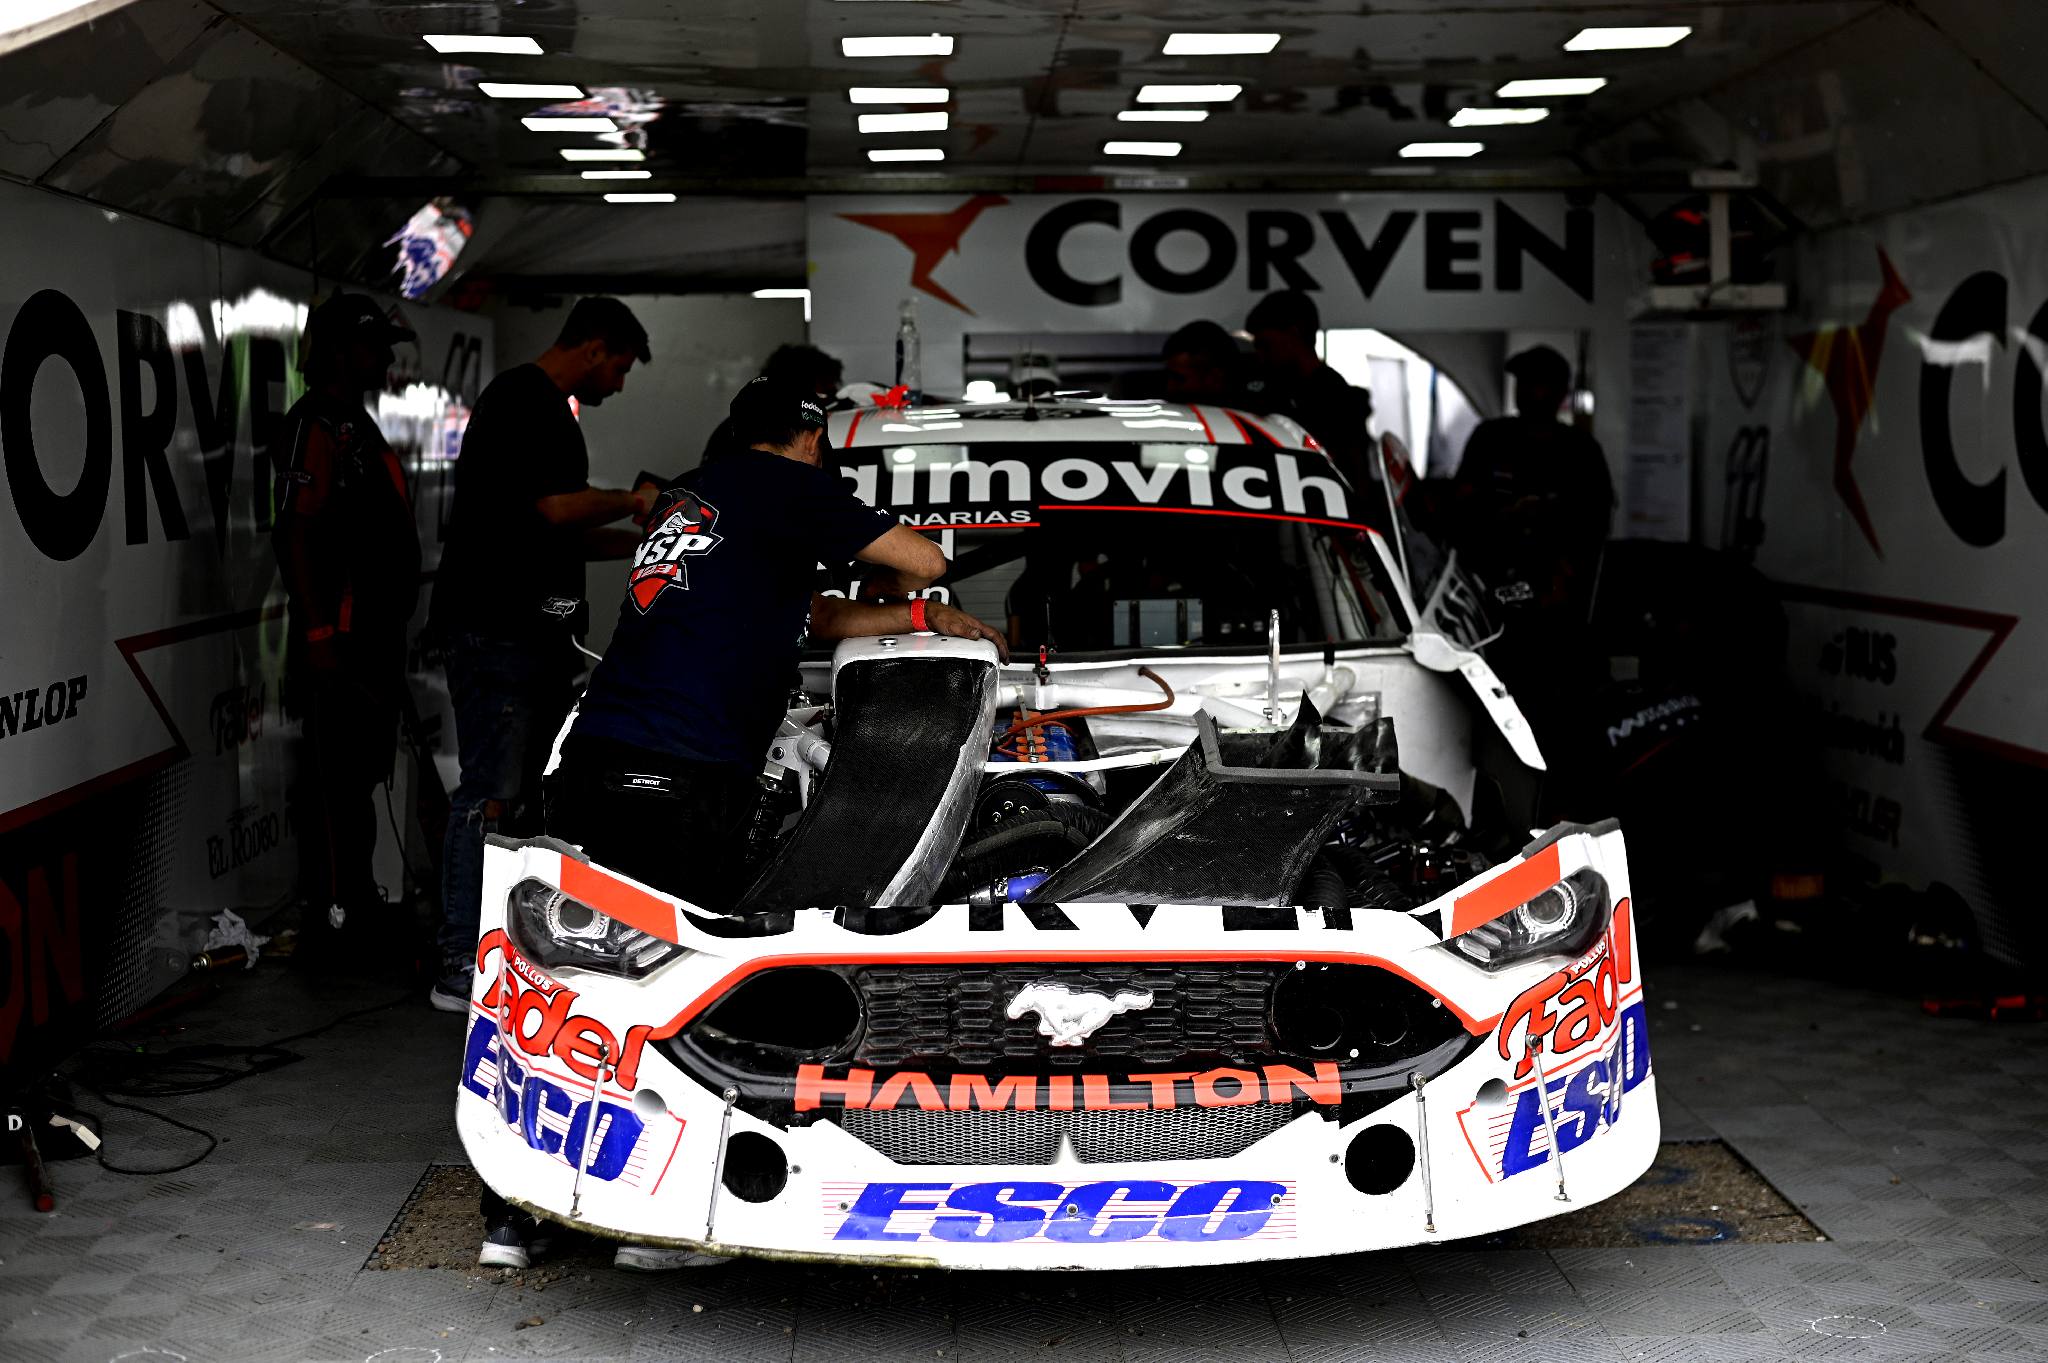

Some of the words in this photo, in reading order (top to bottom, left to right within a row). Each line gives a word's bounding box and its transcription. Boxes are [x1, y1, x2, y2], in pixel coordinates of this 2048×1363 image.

[1025, 200, 1594, 304] CORVEN
[632, 778, 661, 786] DETROIT
[514, 956, 554, 991] POLLOS
[462, 1015, 646, 1182] ESCO
[795, 1063, 1342, 1113] HAMILTON
[832, 1181, 1288, 1244] ESCO
